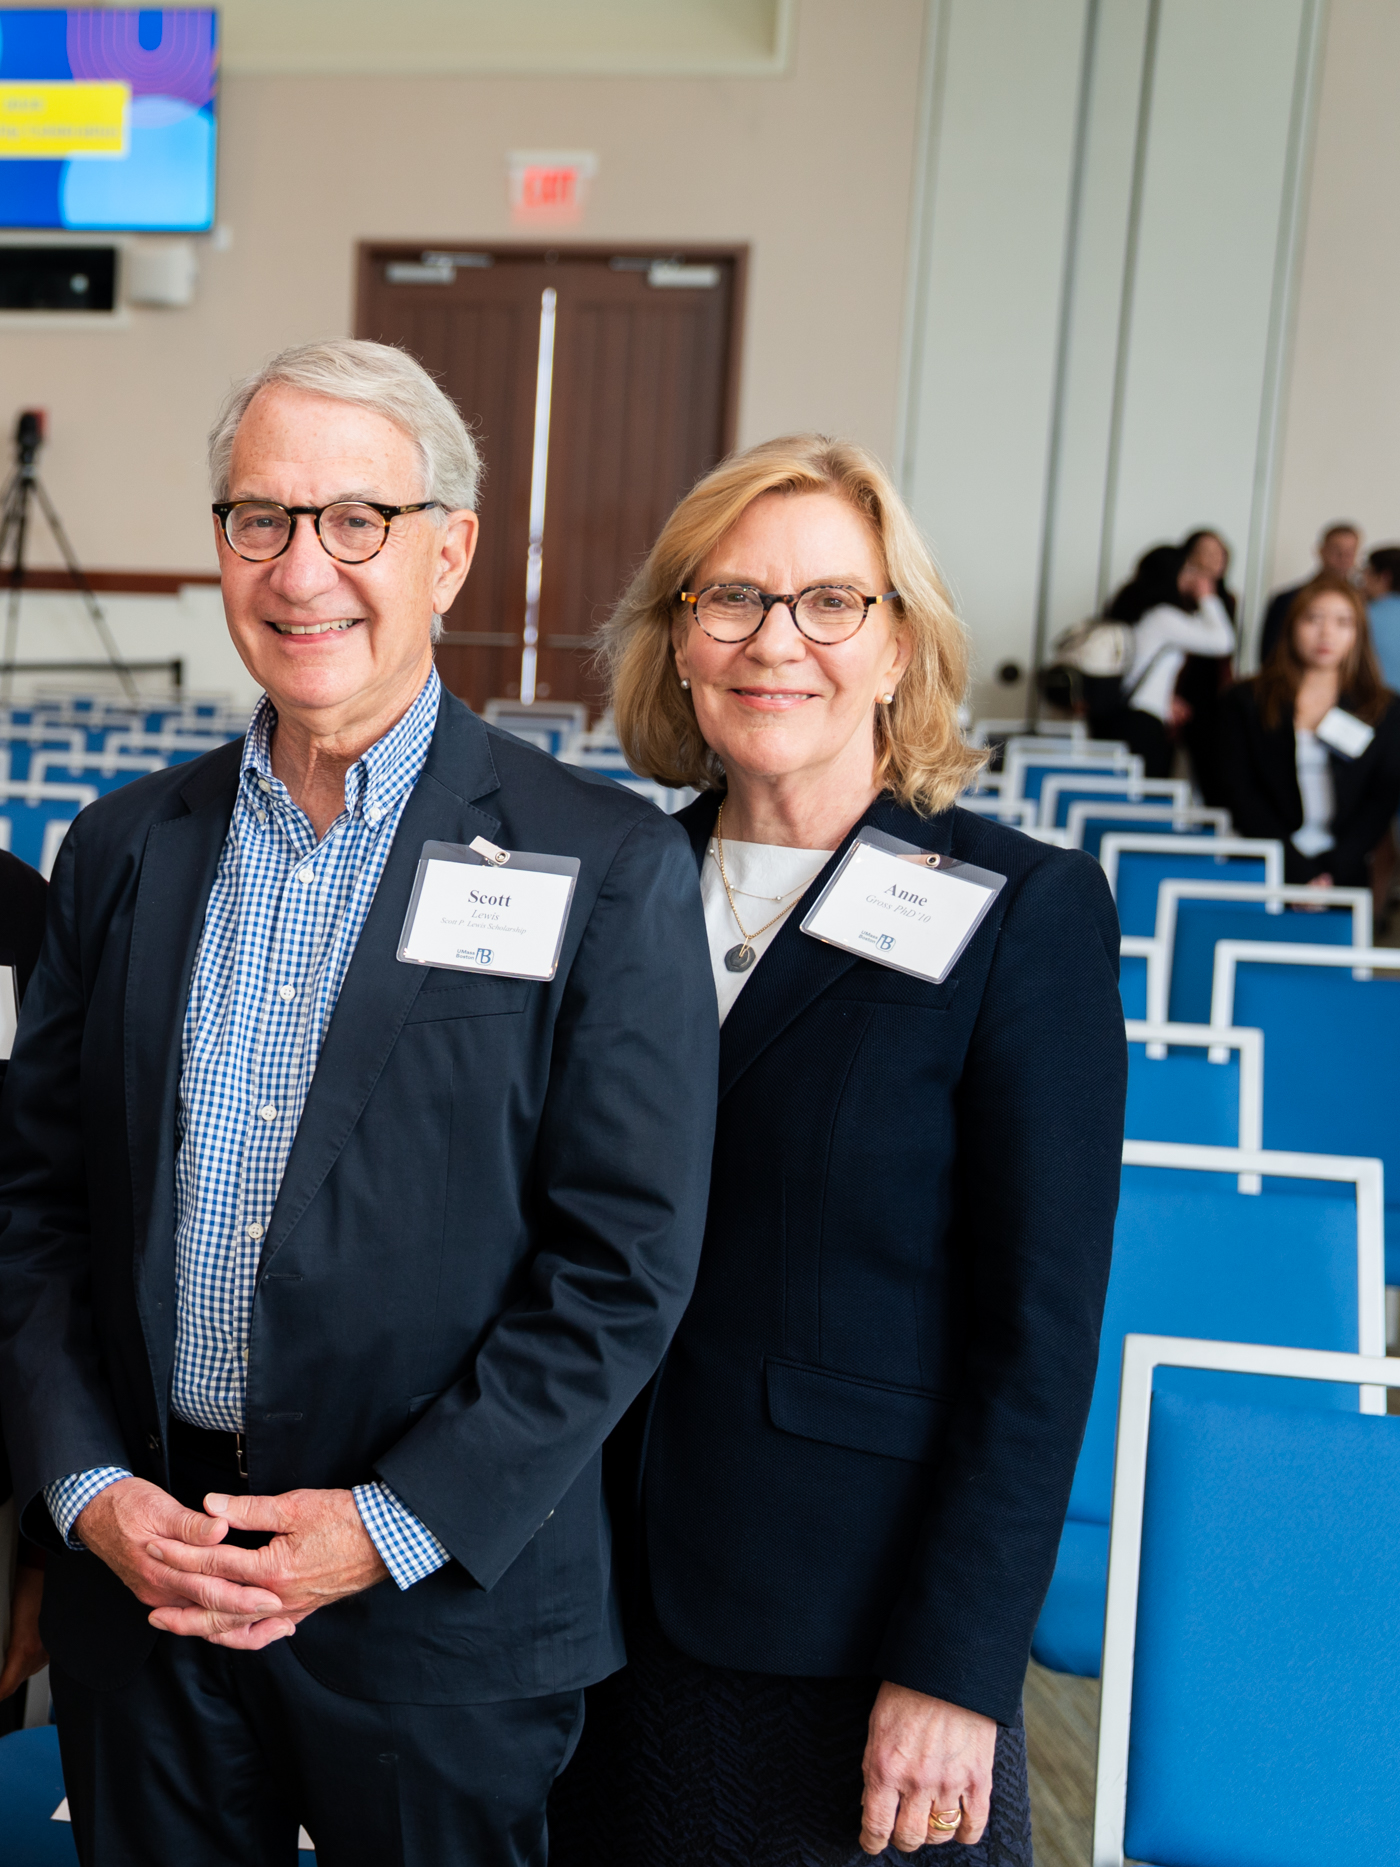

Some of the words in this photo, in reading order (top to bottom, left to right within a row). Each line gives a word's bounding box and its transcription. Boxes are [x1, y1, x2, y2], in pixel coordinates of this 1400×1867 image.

[468, 889, 512, 908] Scott
[884, 884, 928, 907] Anne
[471, 909, 500, 921] Lewis
[865, 894, 893, 910] Gross
[893, 905, 917, 918] PhD
[440, 917, 458, 925] Scott
[467, 920, 486, 929] Lewis
[487, 923, 527, 935] Scholarship
[455, 953, 475, 961] Boston
[456, 948, 476, 956] UMass
